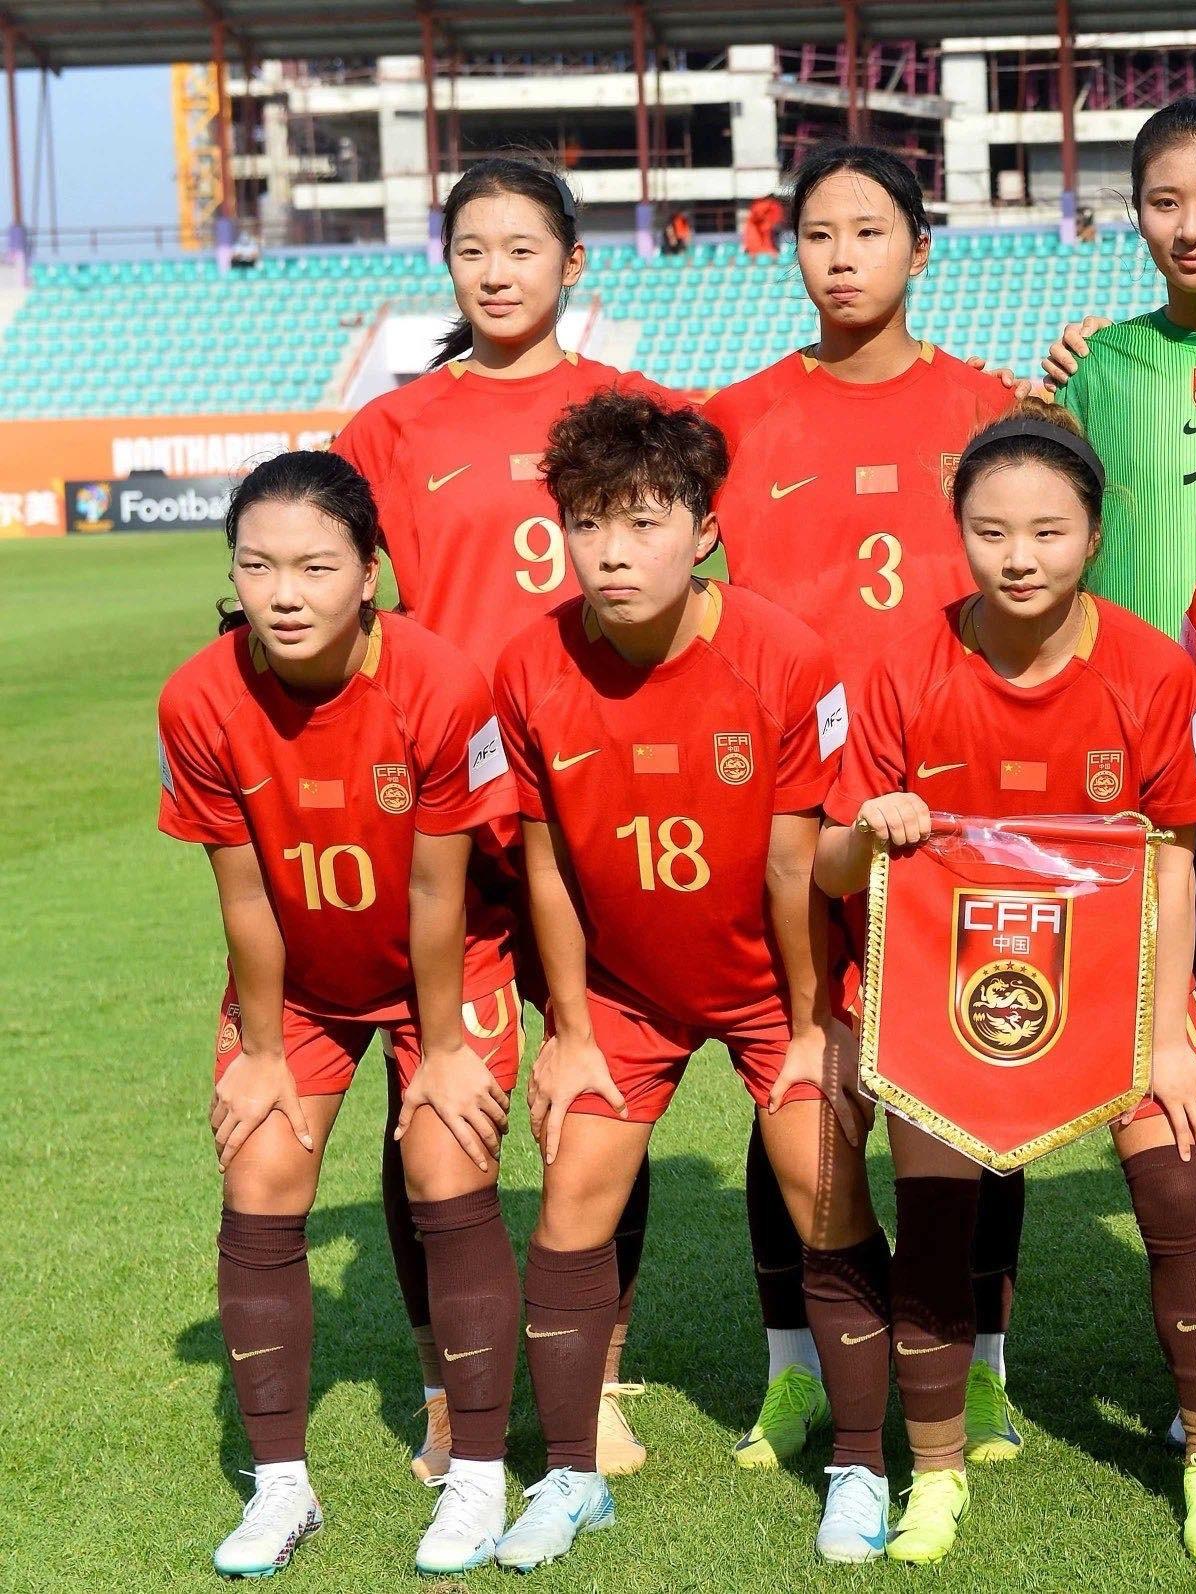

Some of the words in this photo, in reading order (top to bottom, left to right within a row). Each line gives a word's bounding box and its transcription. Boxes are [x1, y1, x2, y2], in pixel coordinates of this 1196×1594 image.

[944, 456, 962, 467] CF
[513, 516, 566, 594] 9
[858, 532, 905, 611] 3
[473, 739, 497, 768] AFC
[718, 736, 749, 747] CFA
[377, 767, 407, 777] CFA
[1090, 753, 1121, 764] CFA
[616, 816, 711, 892] 18
[283, 842, 377, 912] 10
[963, 900, 1061, 934] CFA
[992, 934, 1030, 955] 中国
